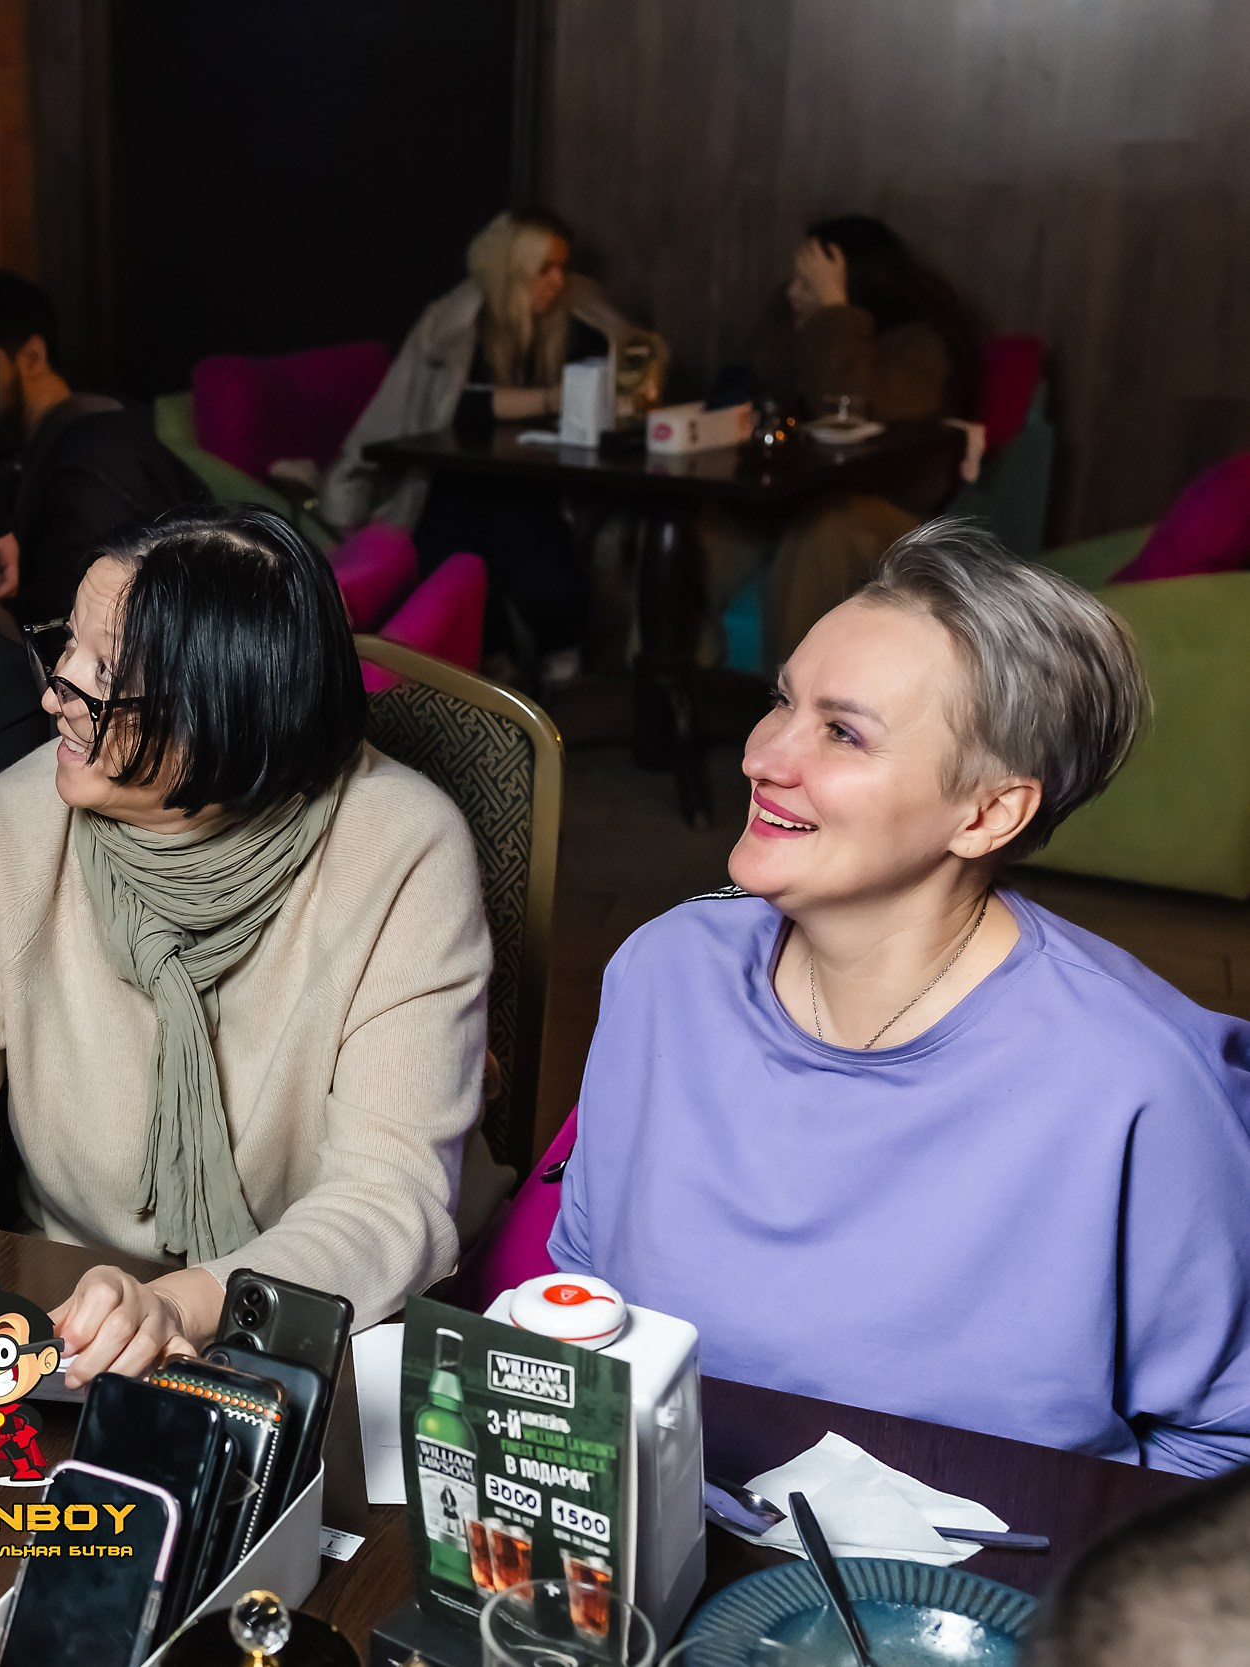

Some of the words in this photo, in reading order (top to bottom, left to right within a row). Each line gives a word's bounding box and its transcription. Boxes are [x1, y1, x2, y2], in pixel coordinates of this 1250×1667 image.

[495, 1356, 562, 1384] WILLIAM
[419, 1441, 473, 1470] WILLIAM
[489, 1478, 537, 1509] 3000
[557, 1505, 606, 1535] 1500
